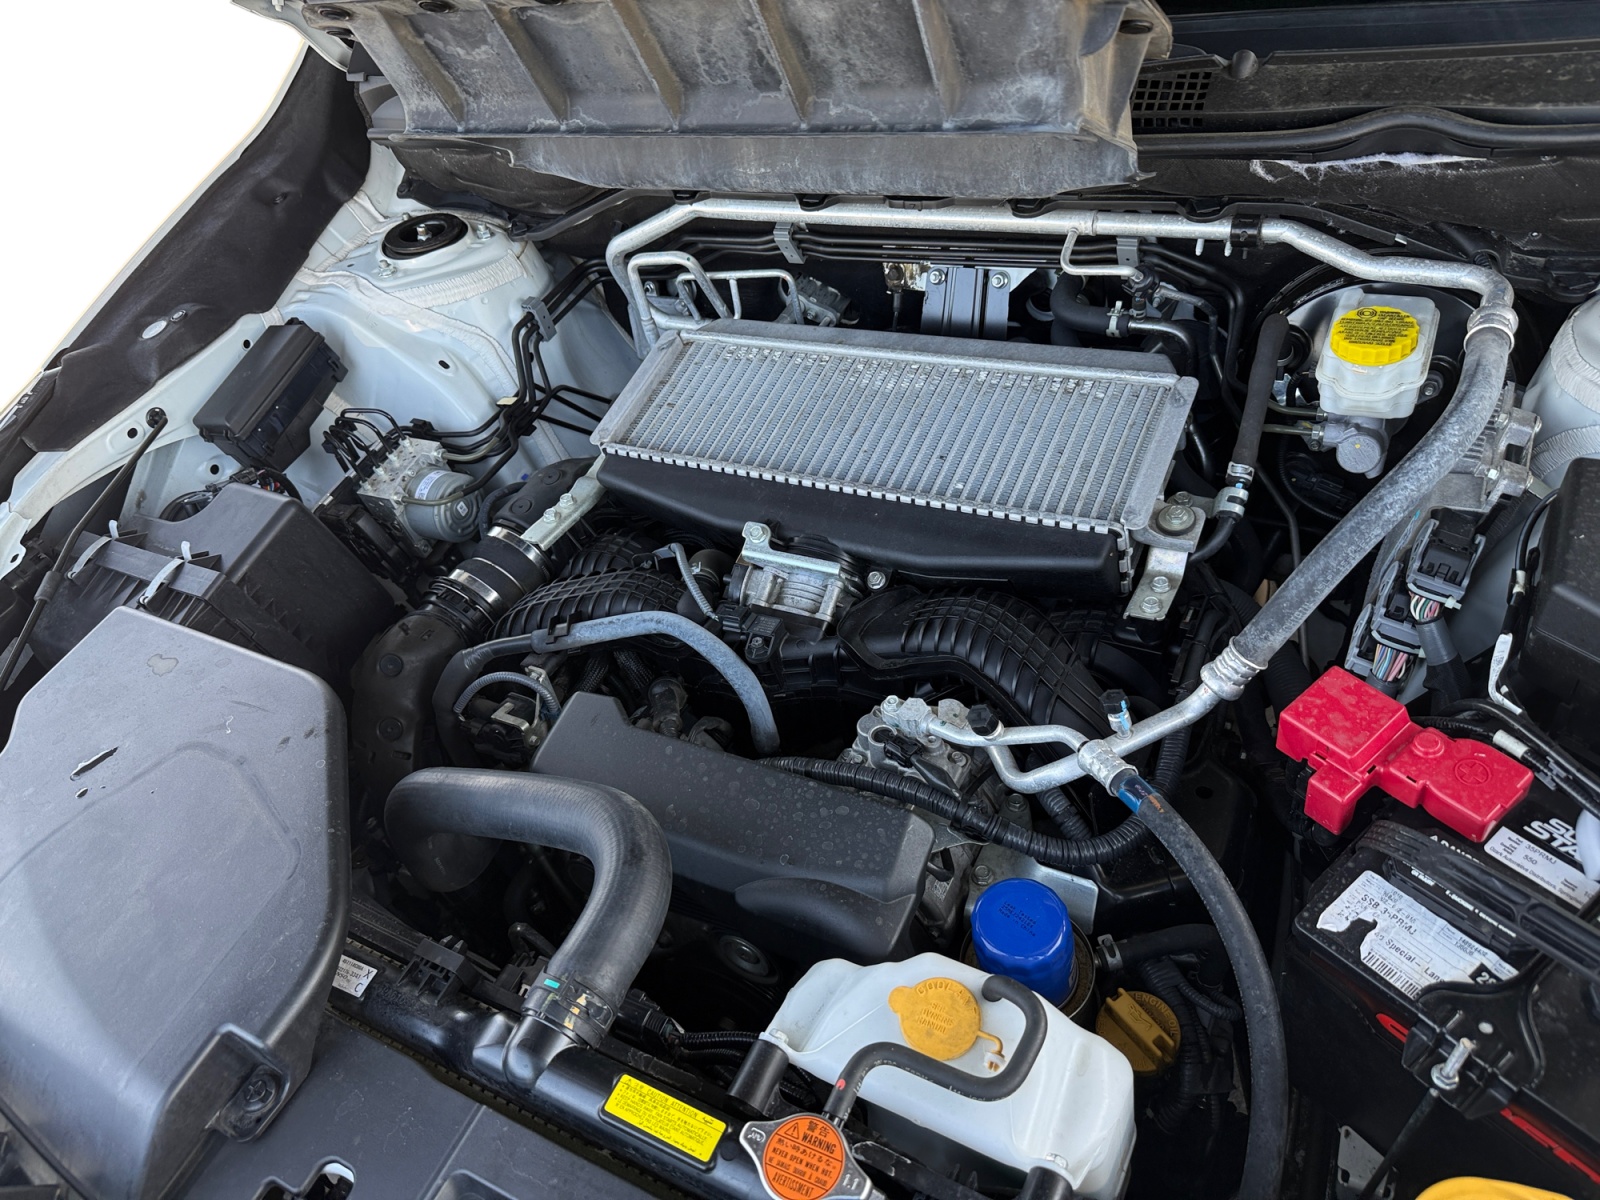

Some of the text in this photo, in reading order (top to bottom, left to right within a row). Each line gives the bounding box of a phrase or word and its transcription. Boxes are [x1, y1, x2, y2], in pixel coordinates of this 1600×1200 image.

[1521, 853, 1538, 866] 550
[1524, 842, 1557, 865] 35PRMJ
[1360, 892, 1380, 910] SSB
[1383, 937, 1416, 964] Special
[1135, 992, 1172, 1019] ENGINE
[1168, 1020, 1179, 1037] OIL
[646, 1088, 669, 1103] CAUTION
[670, 1100, 698, 1118] ATTENTION
[800, 1130, 838, 1155] WARNING
[771, 1146, 789, 1158] NEVER
[789, 1154, 804, 1165] OPEN
[804, 1160, 820, 1172] WHEN
[842, 1173, 859, 1190] 1.1
